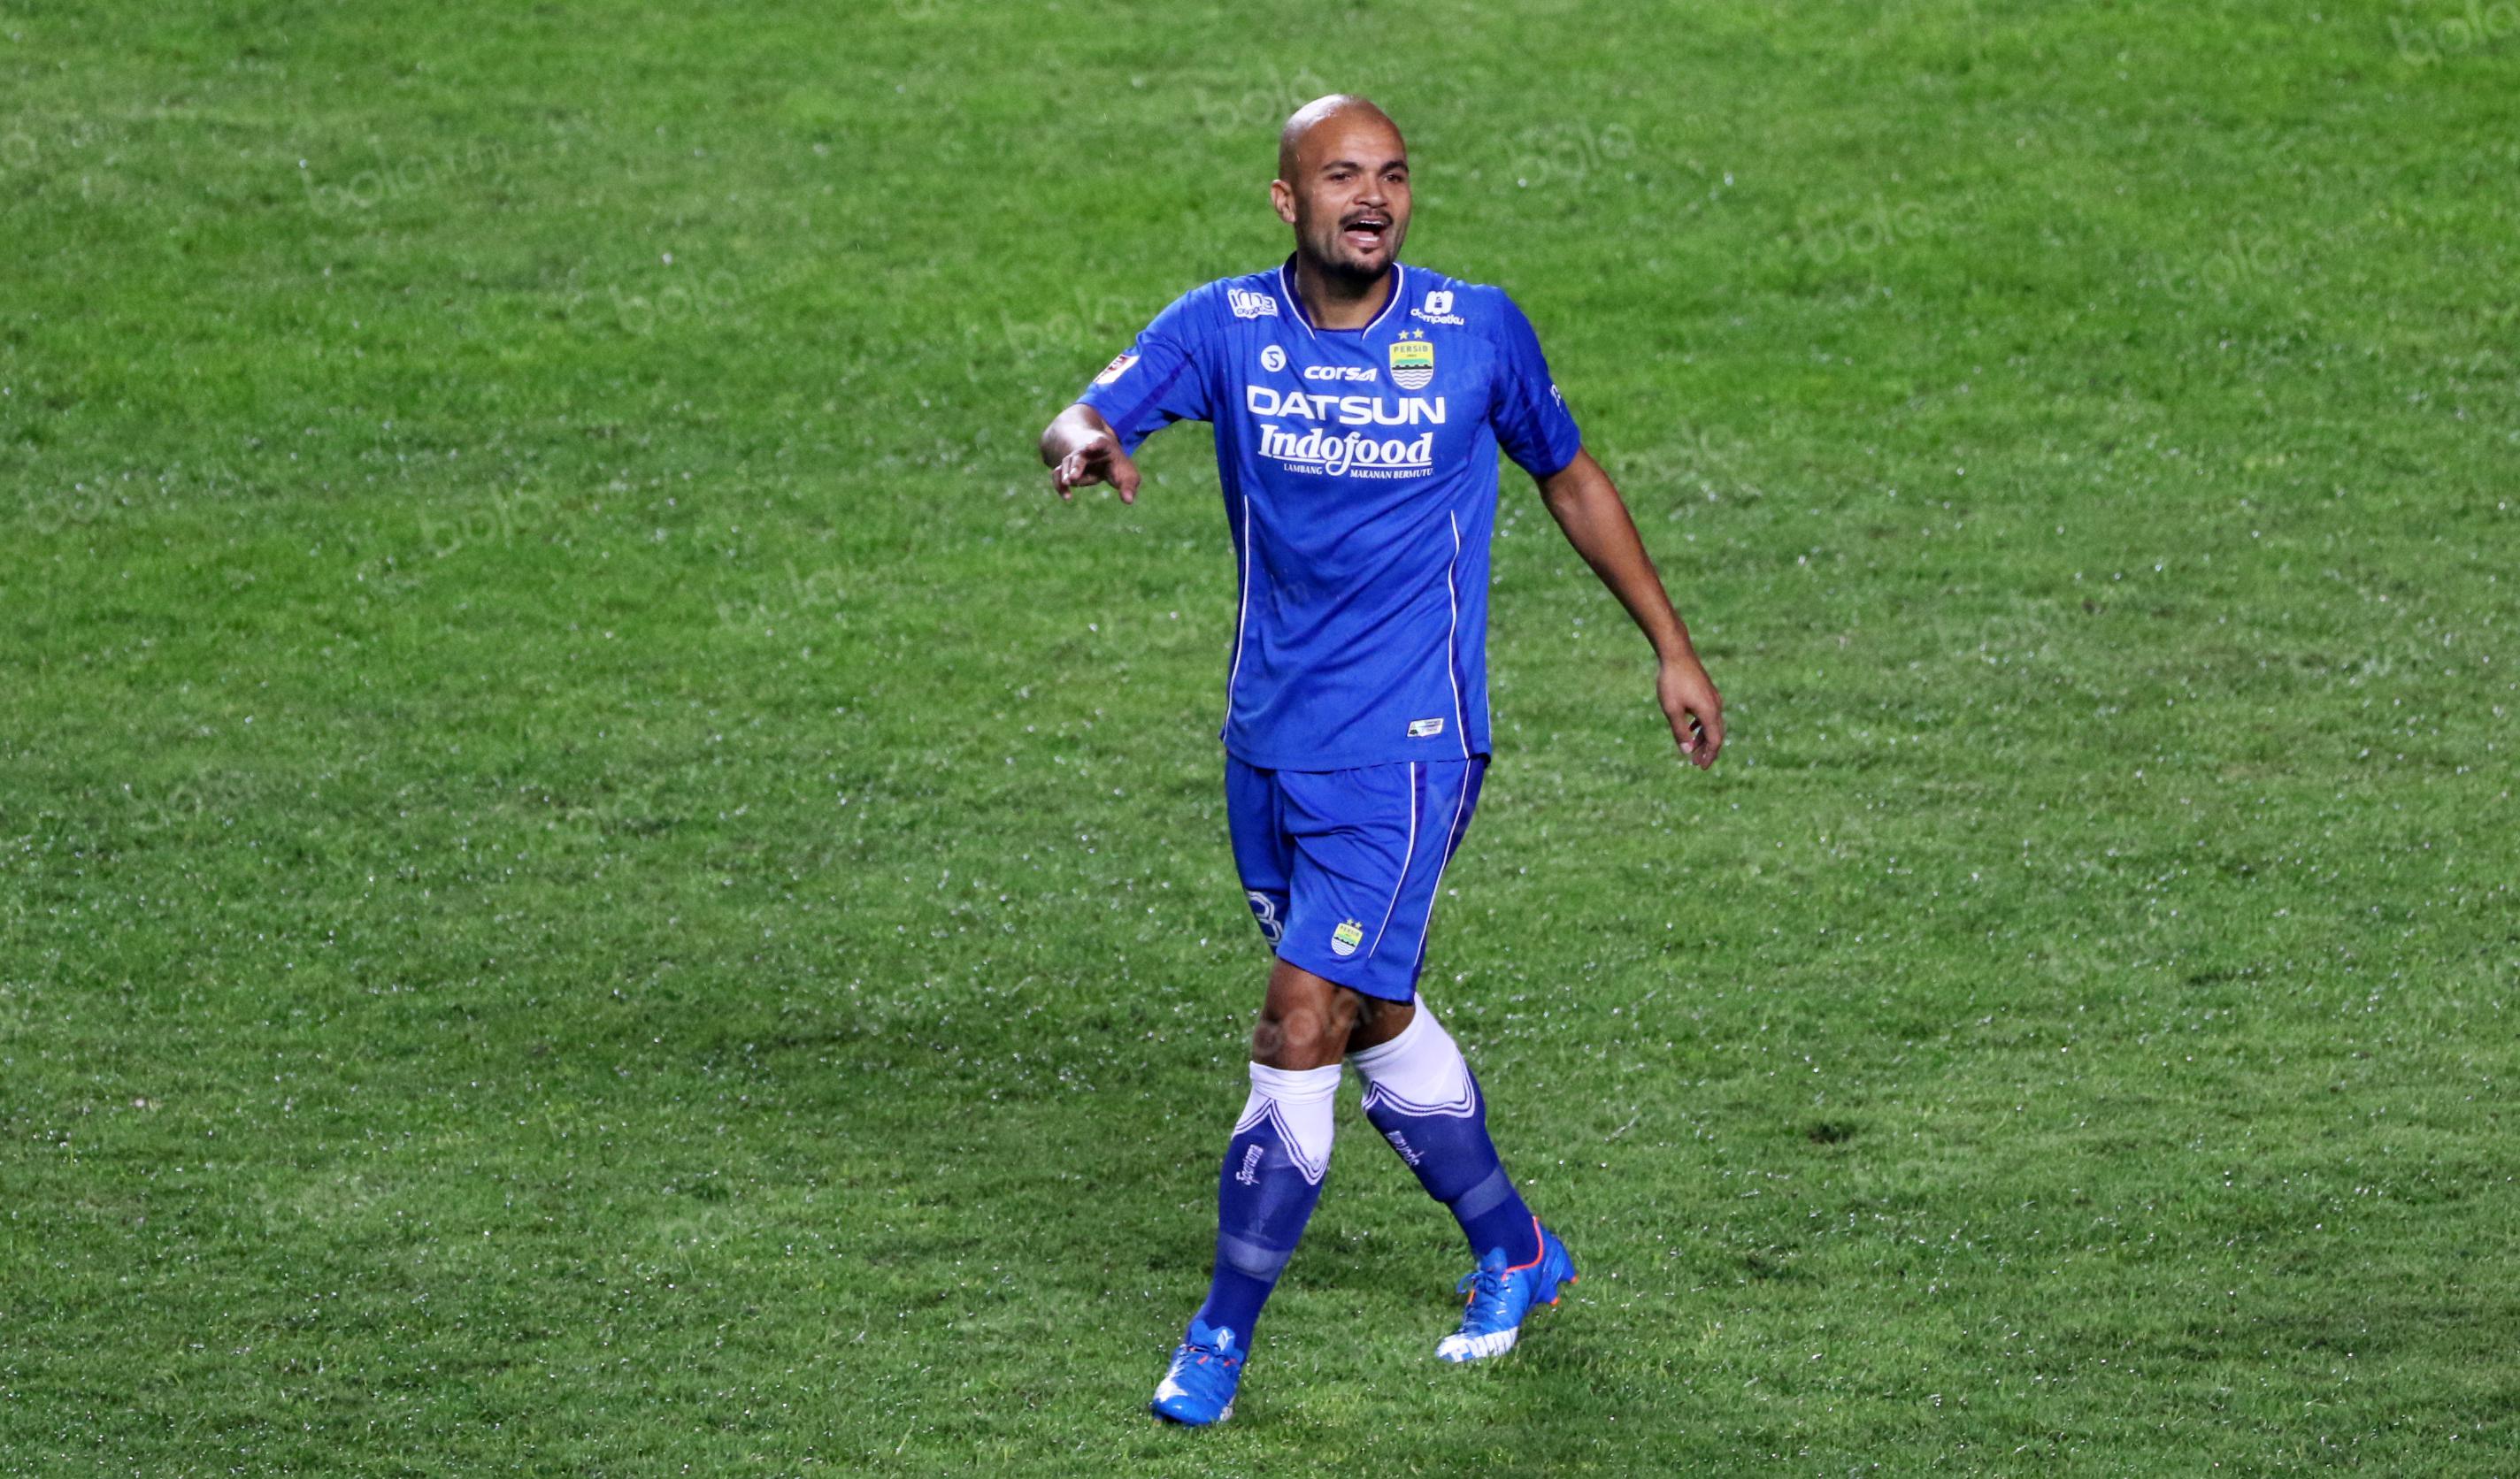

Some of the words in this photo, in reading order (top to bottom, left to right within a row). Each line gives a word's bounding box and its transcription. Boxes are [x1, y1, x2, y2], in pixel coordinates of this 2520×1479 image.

[1247, 385, 1446, 425] DATSUN
[1257, 424, 1433, 476] Indofood
[1284, 464, 1322, 475] LAMBANG
[1350, 469, 1392, 479] MAKANAN
[1393, 468, 1433, 479] BERMUTU
